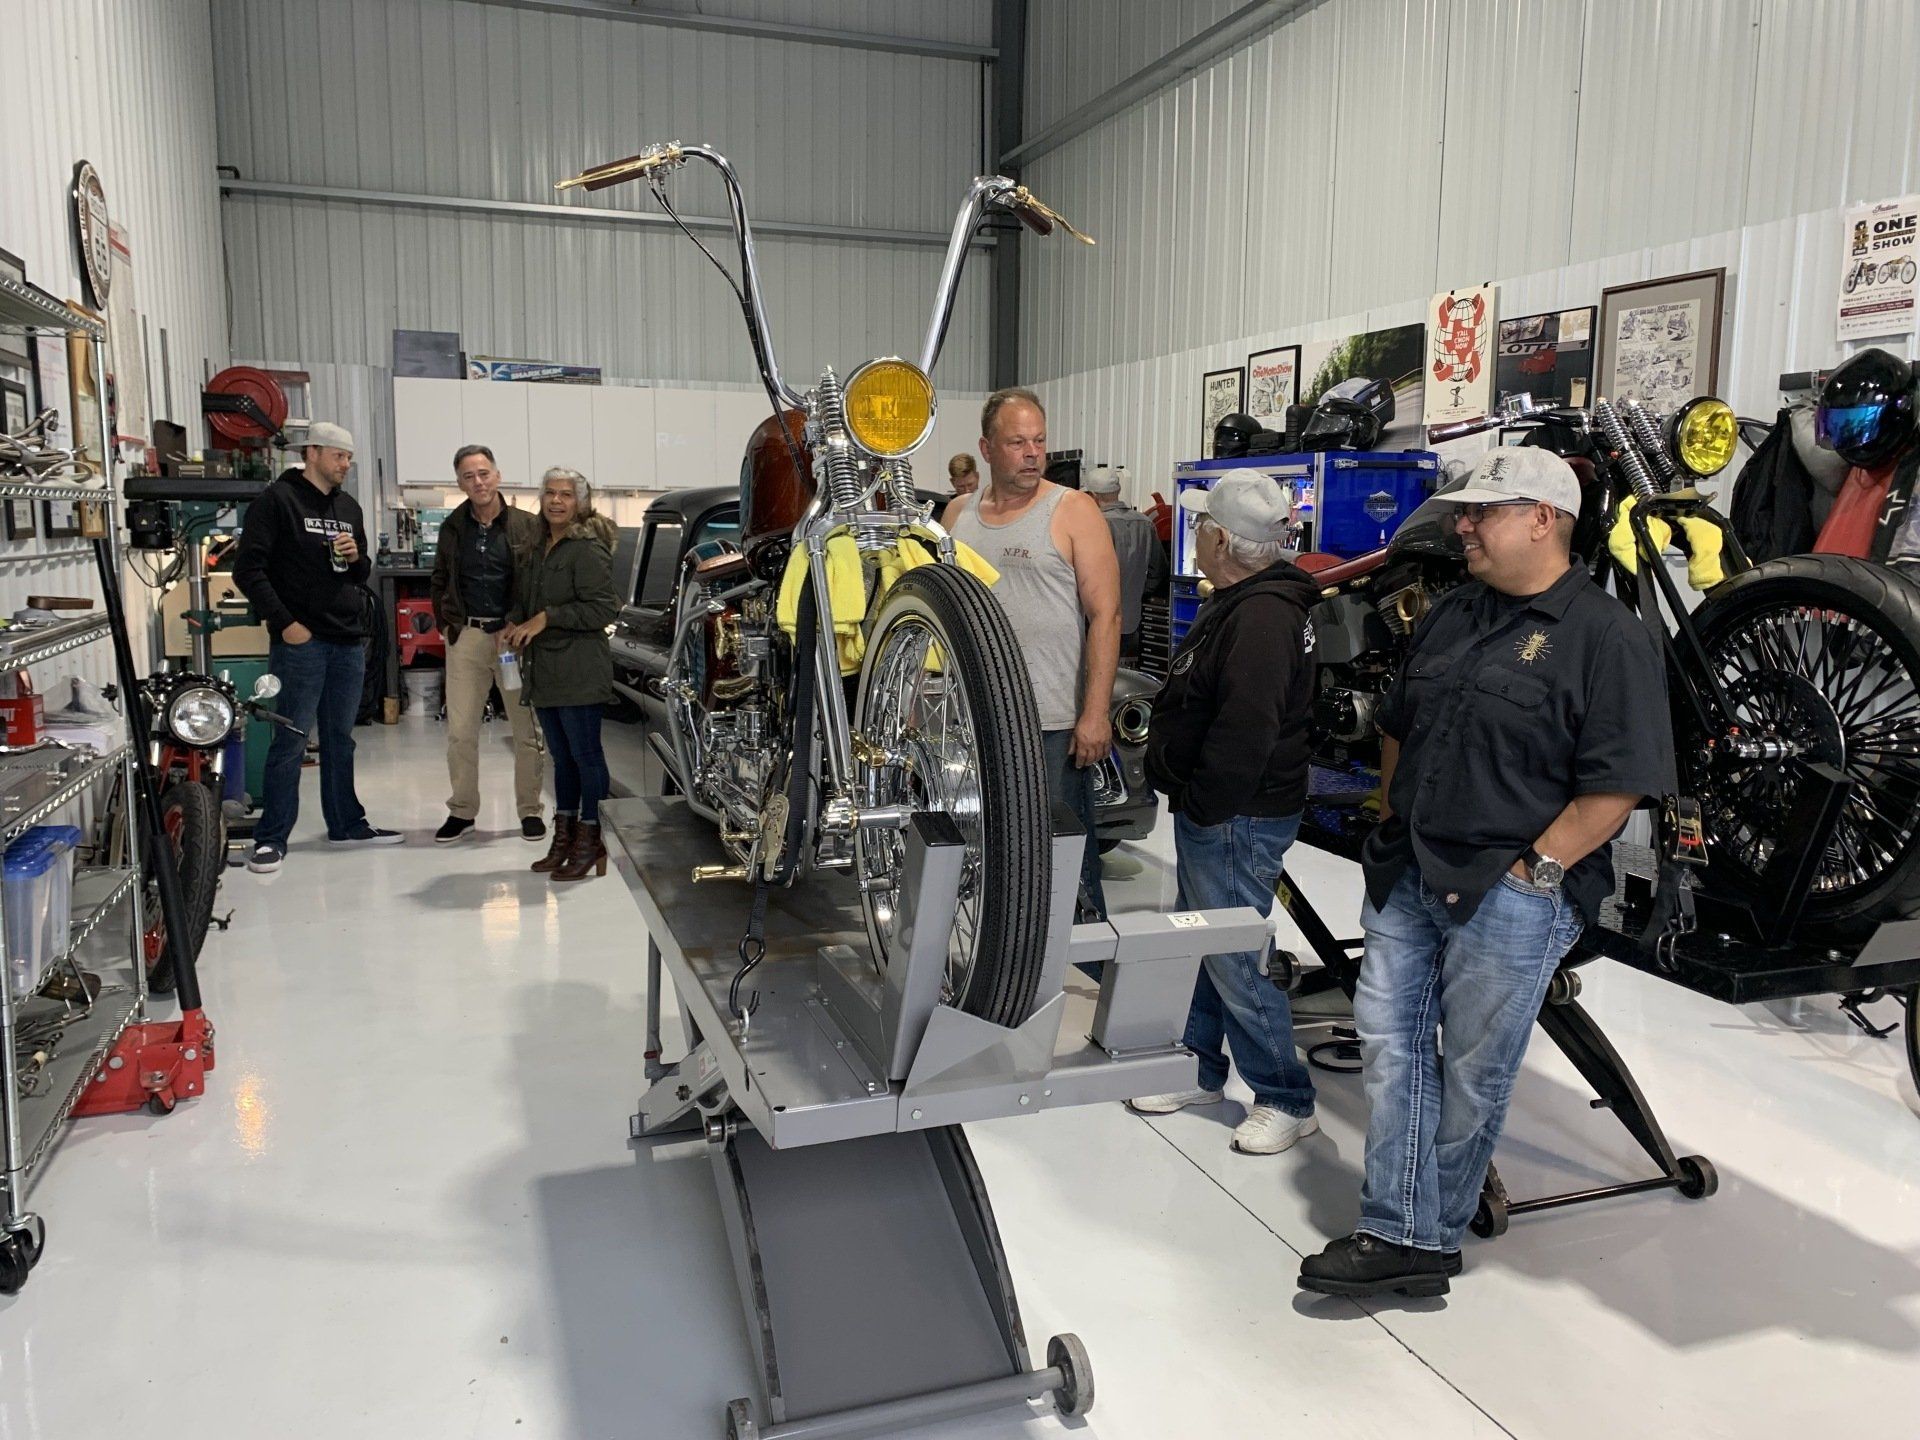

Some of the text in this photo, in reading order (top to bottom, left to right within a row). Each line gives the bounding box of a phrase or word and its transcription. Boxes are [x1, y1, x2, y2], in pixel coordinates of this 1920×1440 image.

[1873, 214, 1918, 234] ONE
[1872, 235, 1916, 251] SHOW
[1210, 377, 1236, 392] HUNTER
